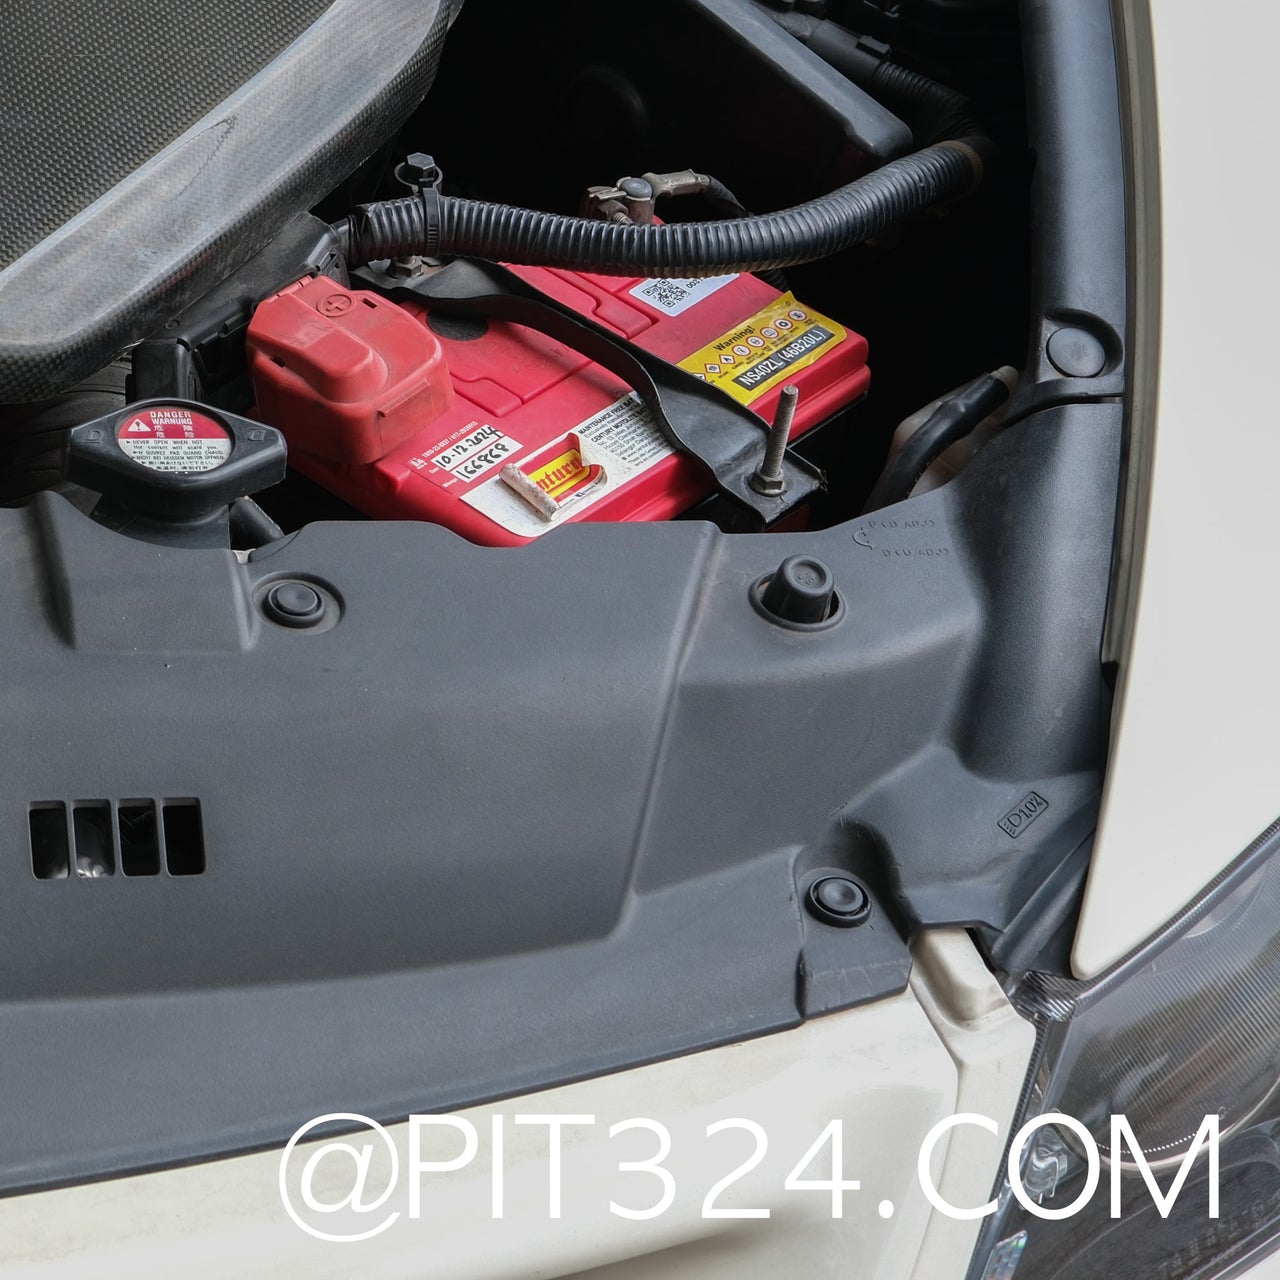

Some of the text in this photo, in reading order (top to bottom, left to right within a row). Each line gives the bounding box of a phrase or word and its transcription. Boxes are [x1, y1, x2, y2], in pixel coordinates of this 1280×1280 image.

[713, 325, 756, 351] Warning!
[738, 359, 784, 386] NS40ZL
[777, 329, 827, 361] (46B20L)
